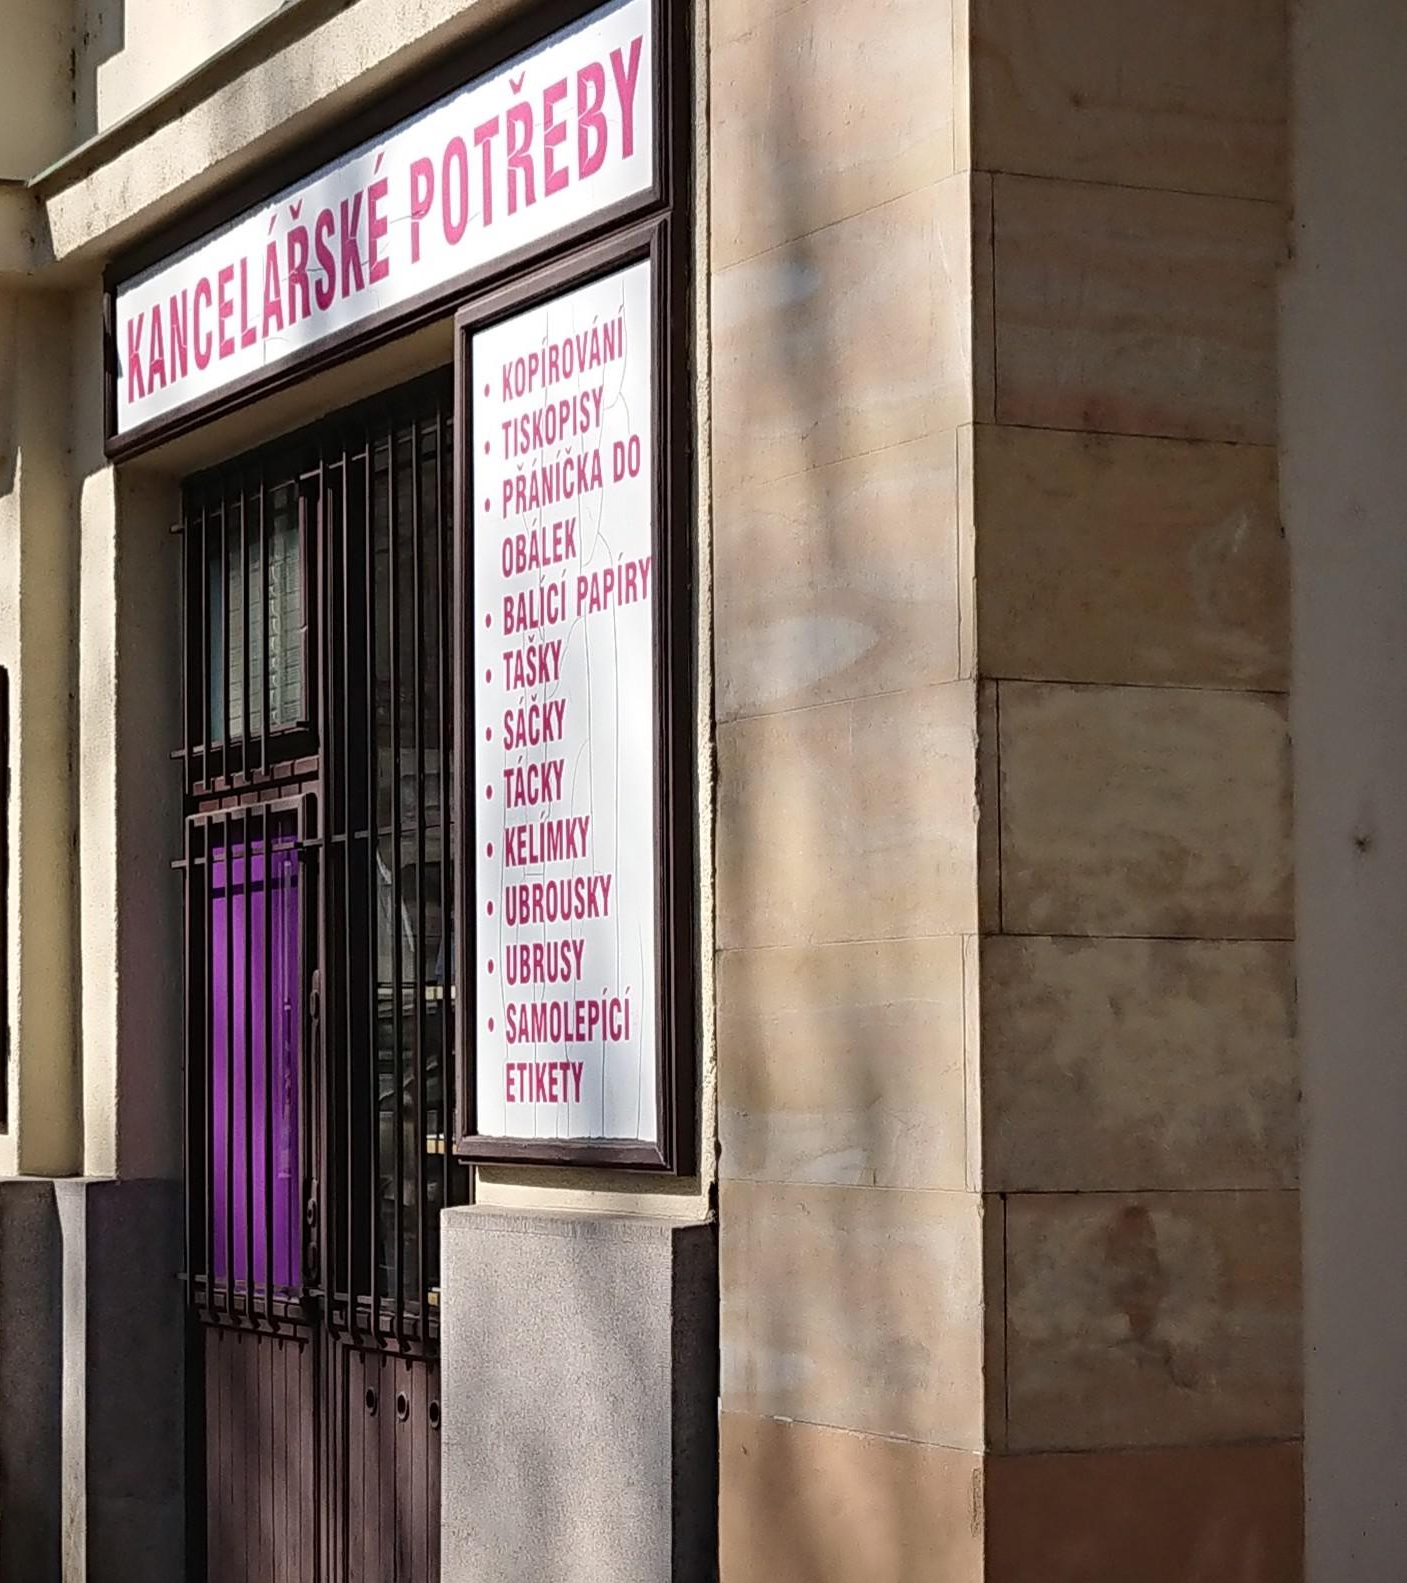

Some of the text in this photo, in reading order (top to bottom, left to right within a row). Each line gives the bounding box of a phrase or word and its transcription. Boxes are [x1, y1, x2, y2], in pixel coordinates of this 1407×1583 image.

[126, 35, 644, 404] KANCELÁŘSKÉ POTŘEBY
[501, 304, 625, 403] KOPÍROVÁNÍ
[501, 385, 604, 461] TISKOPISY
[501, 433, 642, 520] PŘÁNÍČKA DO
[501, 516, 578, 579] OBÁLEK
[502, 551, 653, 636] BALÍCÍ PAPÍRY
[502, 635, 563, 692] TAŠKY
[503, 693, 566, 751] SÁČKY
[503, 755, 566, 809] TÁCKY
[504, 809, 591, 868] KELÍMKY
[505, 874, 613, 926] UBROUSKY
[505, 939, 585, 986] UBRUSY
[505, 986, 631, 1045] SAMOLEPÍCÍ
[505, 1060, 585, 1104] ETIKETY
